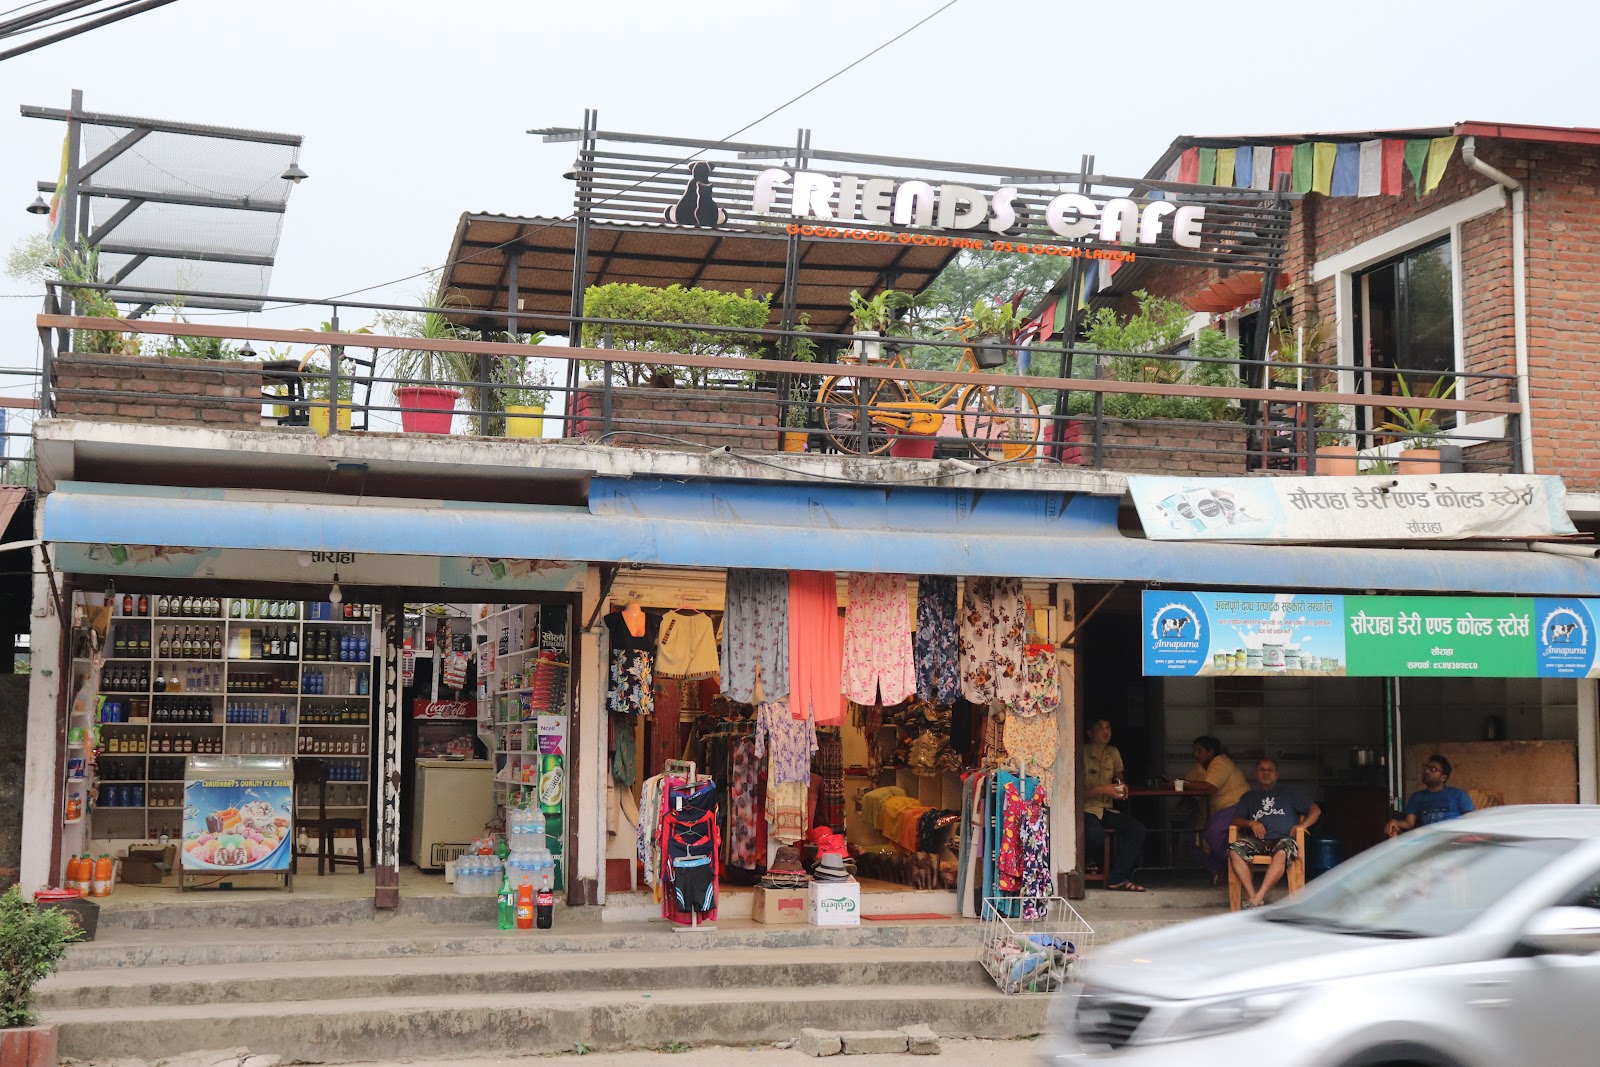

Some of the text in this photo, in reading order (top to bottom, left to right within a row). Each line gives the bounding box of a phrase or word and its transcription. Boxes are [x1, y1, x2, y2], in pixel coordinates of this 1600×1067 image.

[752, 168, 1206, 249] FRIENDS CAFE
[785, 224, 840, 239] GOOD
[897, 233, 950, 248] GOOD
[952, 239, 1014, 253] FRIEDS
[1016, 243, 1030, 254] &
[1031, 244, 1082, 259] GOOD
[1084, 249, 1136, 263] LAUGH
[1288, 486, 1349, 510] सौराहा
[1352, 486, 1388, 509] डेरी
[1389, 491, 1431, 509] एण्ड
[1434, 486, 1484, 509] कोल्ड
[1406, 519, 1443, 534] सौराहा
[1350, 609, 1530, 637] सौराहा डेरी एण्ड कोल्ड स्टोर्स
[1152, 638, 1200, 650] Annapurna
[1430, 646, 1454, 656] सौराहा
[1543, 644, 1587, 656] Annapurna
[542, 776, 560, 801] TUBORG
[820, 896, 856, 912] Carlsberg
